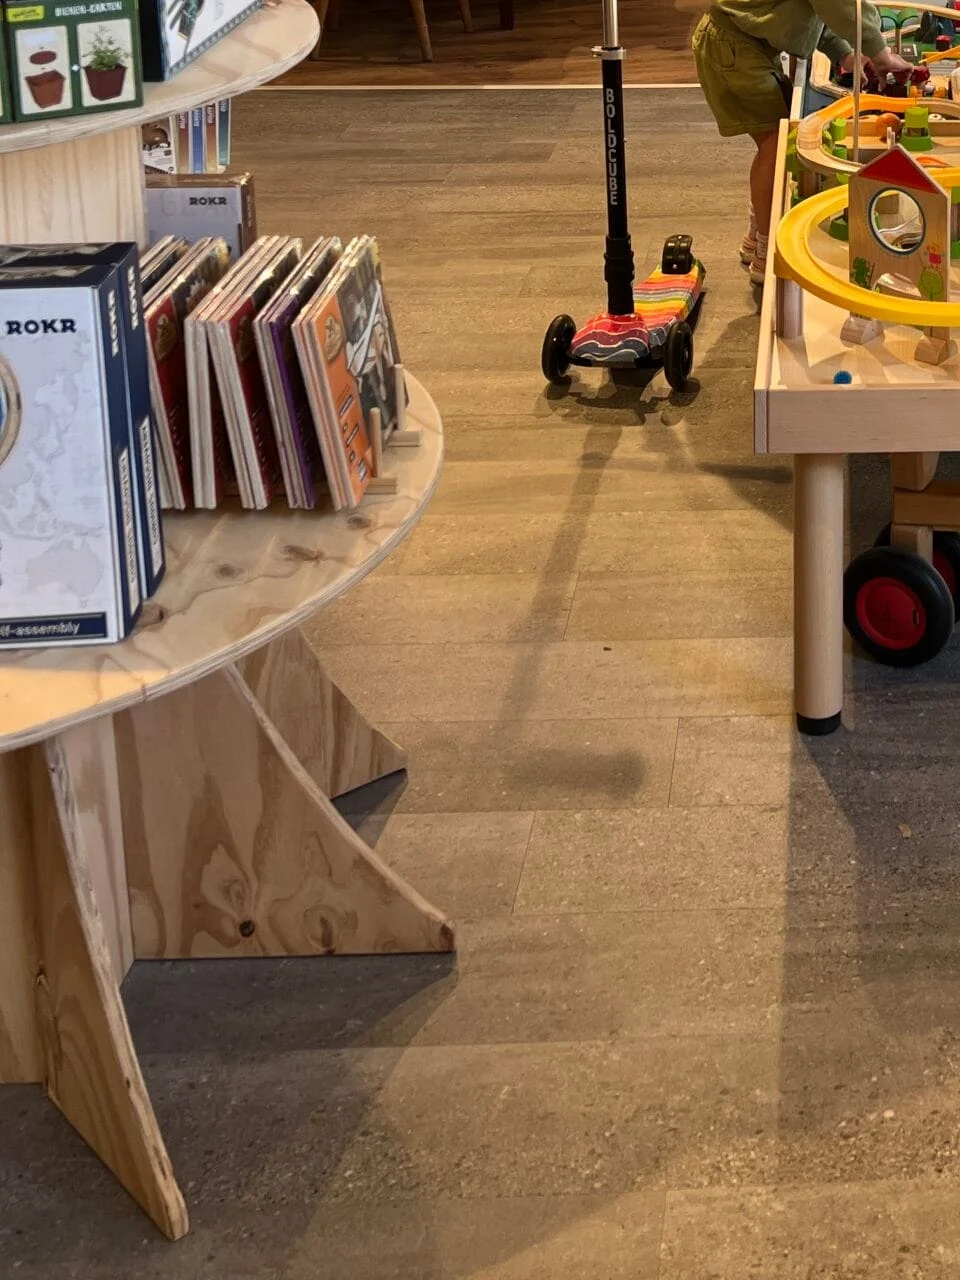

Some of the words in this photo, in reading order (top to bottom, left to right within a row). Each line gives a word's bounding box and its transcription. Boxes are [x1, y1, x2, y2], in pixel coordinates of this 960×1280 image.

[606, 88, 618, 206] BOLDCUBE
[189, 197, 228, 206] ROKR
[6, 318, 77, 336] ROKR
